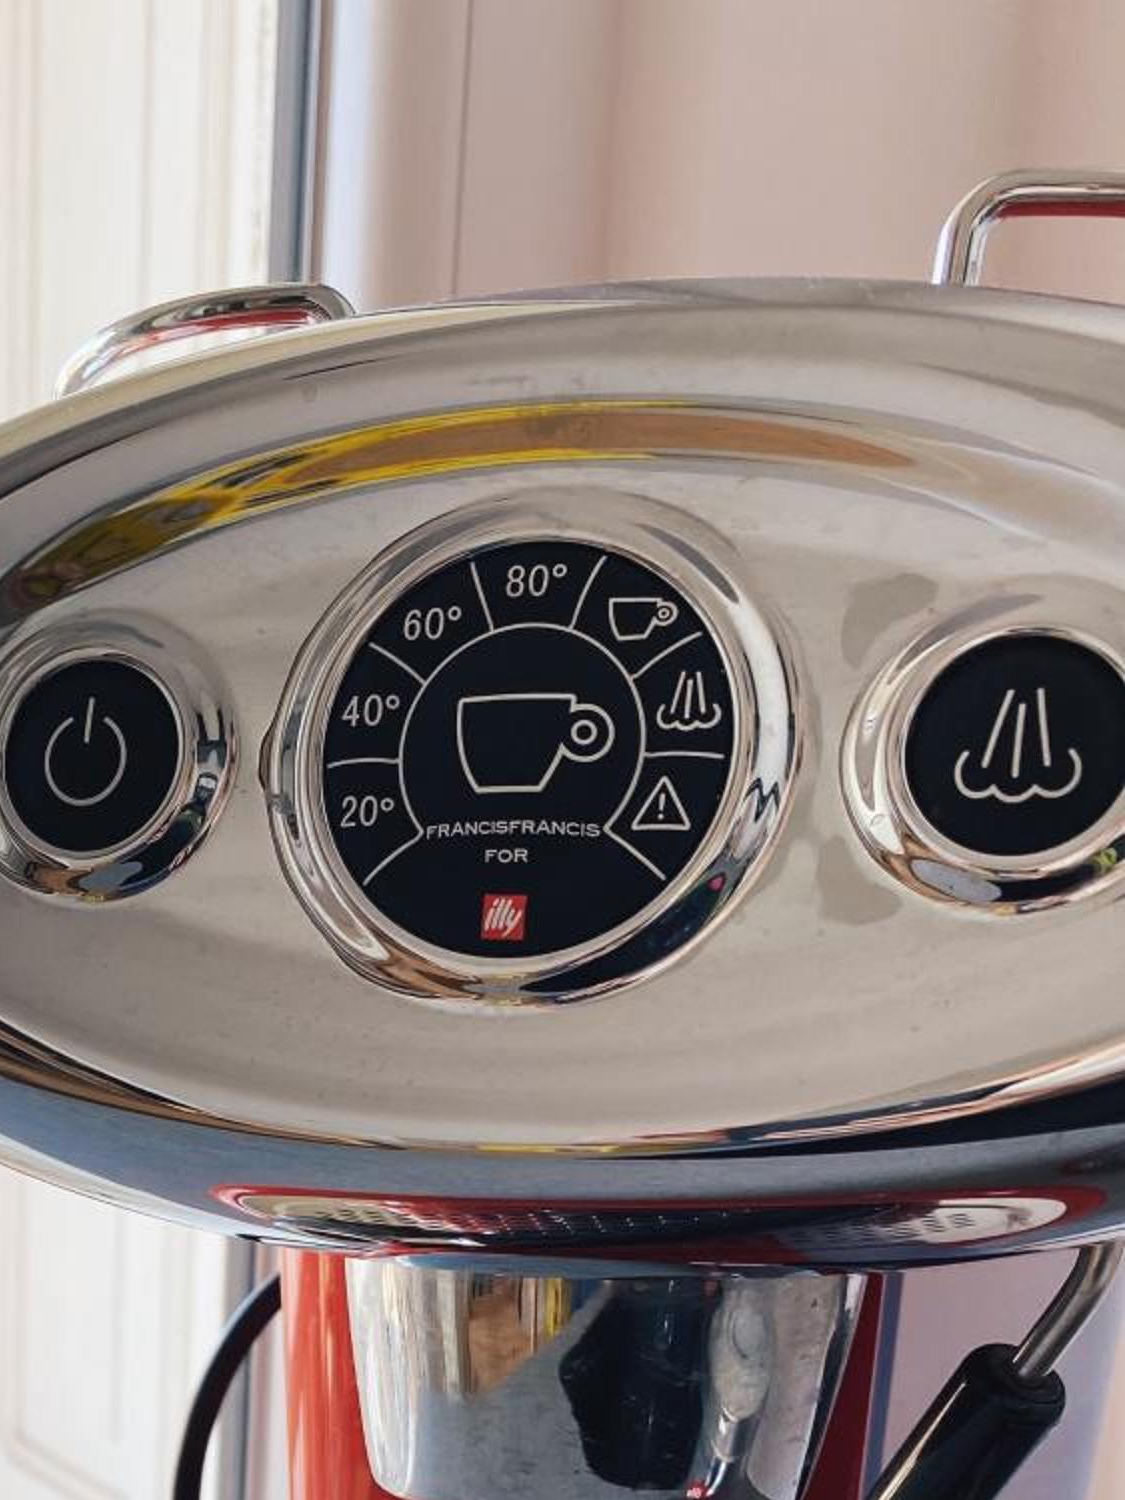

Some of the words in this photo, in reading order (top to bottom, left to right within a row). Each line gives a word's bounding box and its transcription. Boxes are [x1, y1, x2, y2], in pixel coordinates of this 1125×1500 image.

[425, 819, 601, 840] FRANCISFRANCIS
[483, 848, 529, 864] FOR
[484, 897, 523, 937] illy
